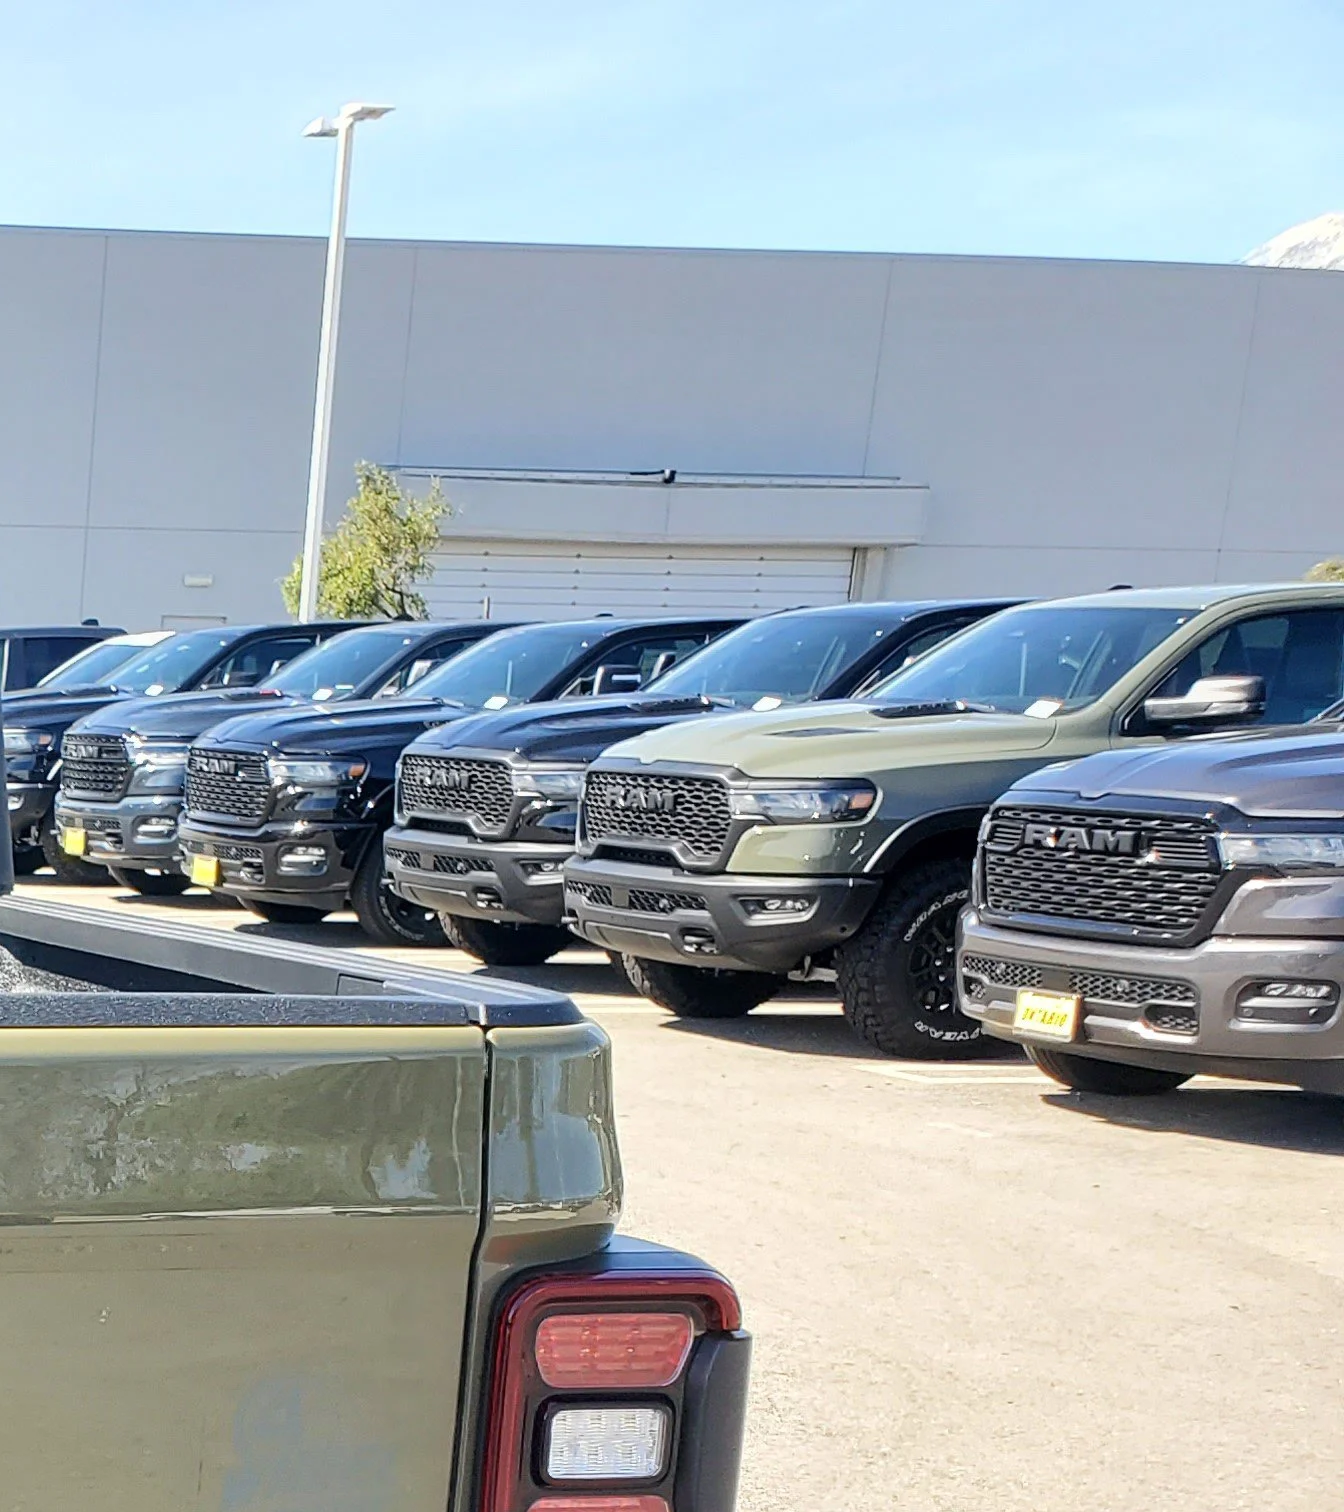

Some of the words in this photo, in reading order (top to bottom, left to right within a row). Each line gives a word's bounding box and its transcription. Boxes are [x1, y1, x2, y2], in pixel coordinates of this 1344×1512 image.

[196, 757, 236, 775] RAM
[415, 766, 469, 790] RAM
[606, 784, 675, 812] RAM
[1024, 823, 1138, 852] RAM
